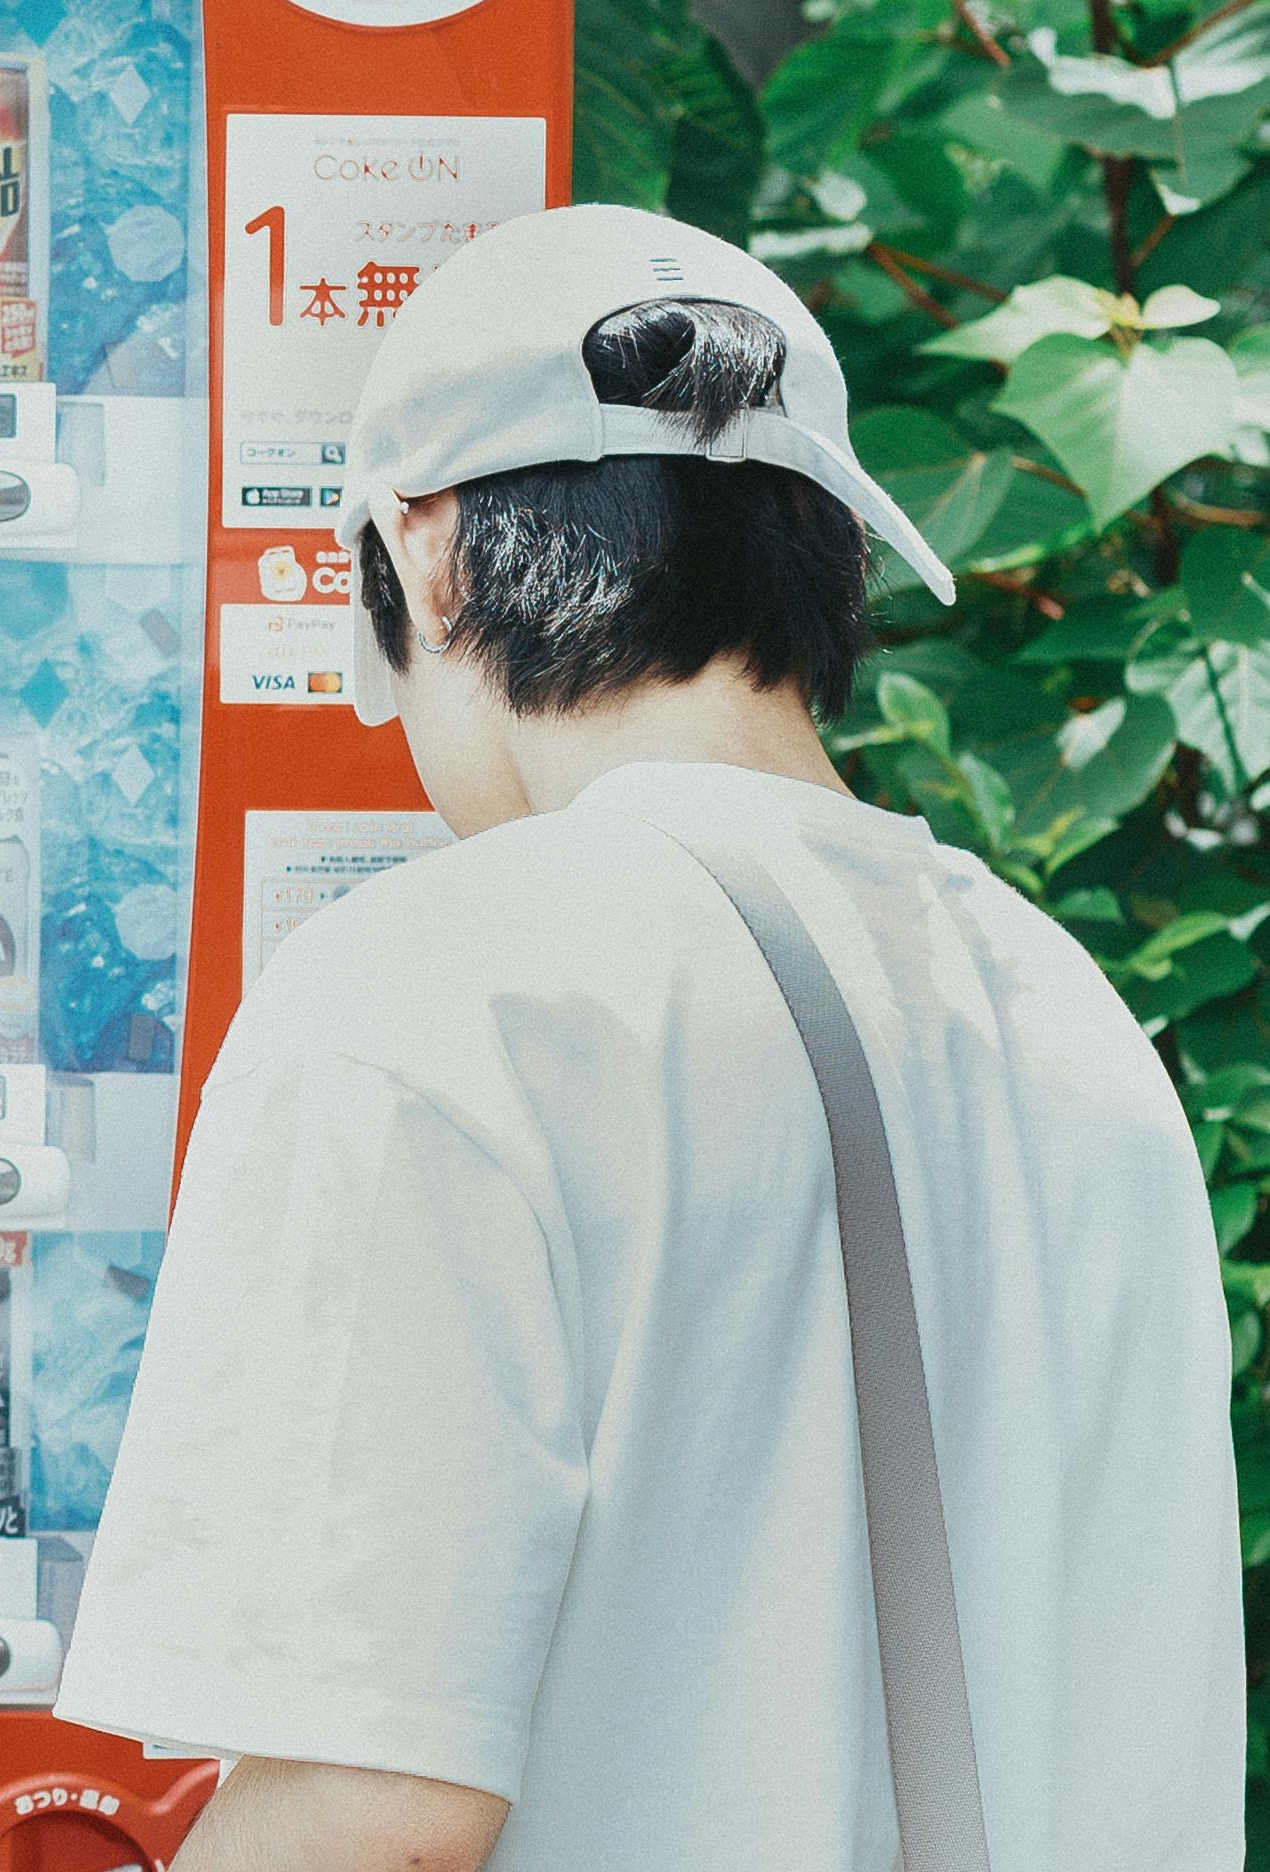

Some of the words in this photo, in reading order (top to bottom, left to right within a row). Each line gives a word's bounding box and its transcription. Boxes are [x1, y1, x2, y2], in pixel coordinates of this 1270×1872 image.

[314, 153, 399, 182] Coke
[408, 150, 460, 183] ON
[245, 205, 443, 328] 1本無
[252, 675, 296, 690] VISA
